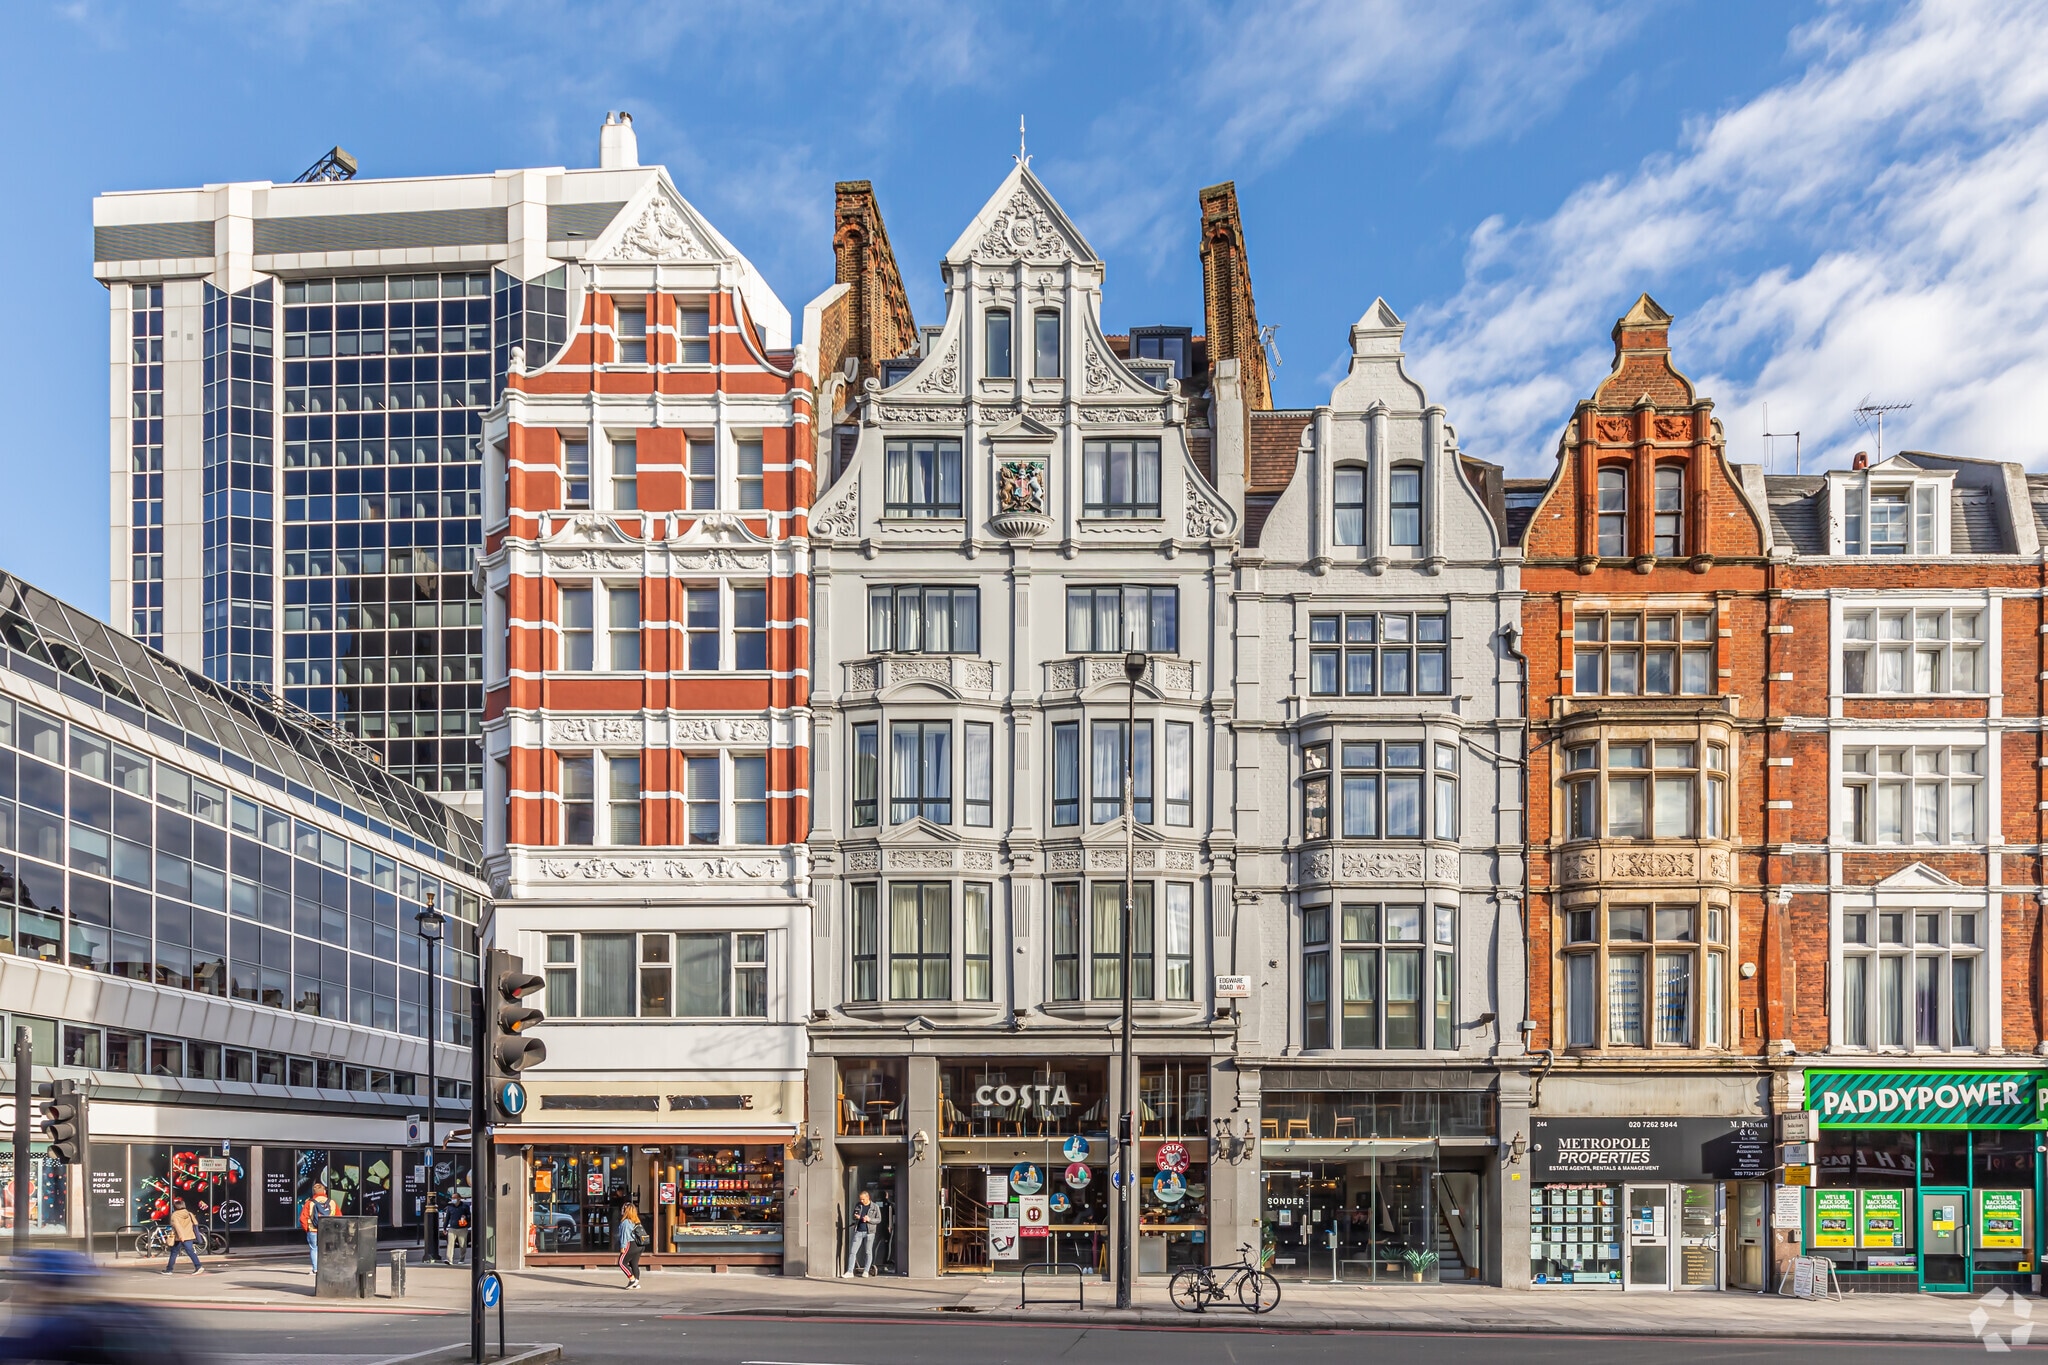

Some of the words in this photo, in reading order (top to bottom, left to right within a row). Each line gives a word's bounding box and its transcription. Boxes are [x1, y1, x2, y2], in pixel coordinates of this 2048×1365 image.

[976, 1085, 1071, 1109] COSTA
[1558, 1138, 1650, 1149] METROPOLE
[1162, 1145, 1183, 1154] COSTA
[1558, 1152, 1650, 1164] PROPERTIES
[1268, 1197, 1304, 1205] SONDER
